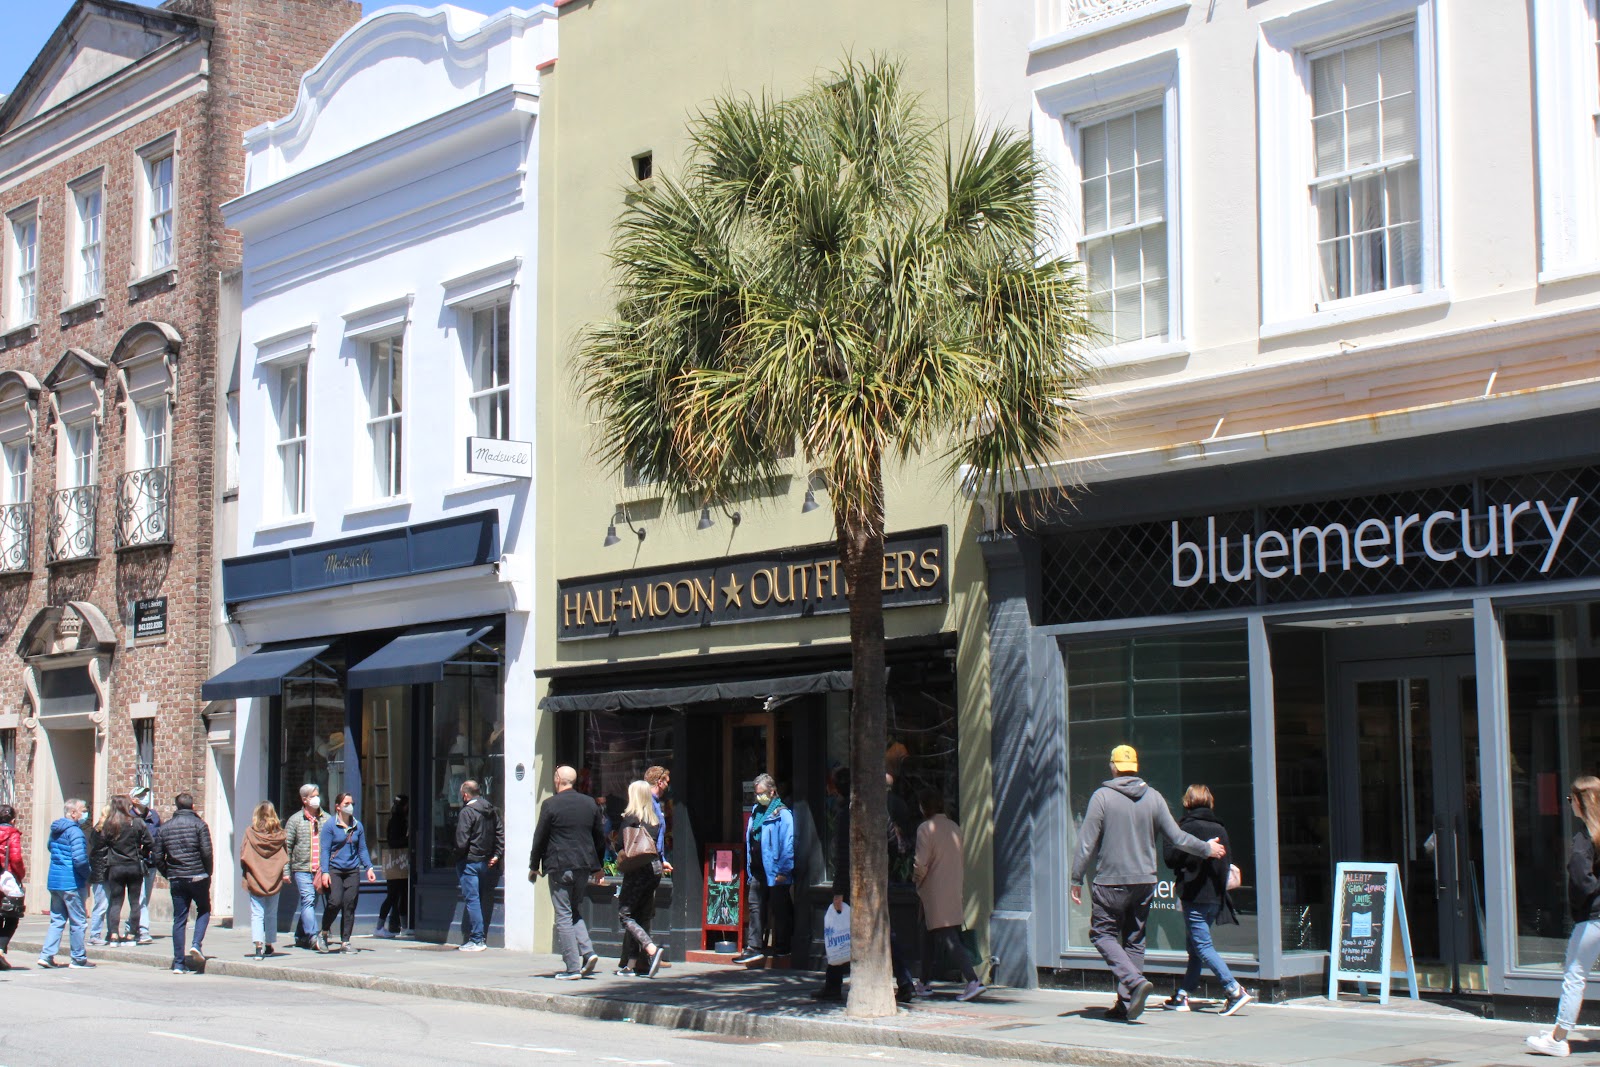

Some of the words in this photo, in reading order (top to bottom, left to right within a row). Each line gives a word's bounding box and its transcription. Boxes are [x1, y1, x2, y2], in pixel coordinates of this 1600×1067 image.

[476, 447, 528, 464] Madewell
[1171, 496, 1579, 588] bluemercury
[564, 575, 716, 627] HALF-MOON
[750, 548, 941, 606] OUTFIERS
[1345, 873, 1372, 882] ALERT!
[1363, 938, 1376, 946] NEW
